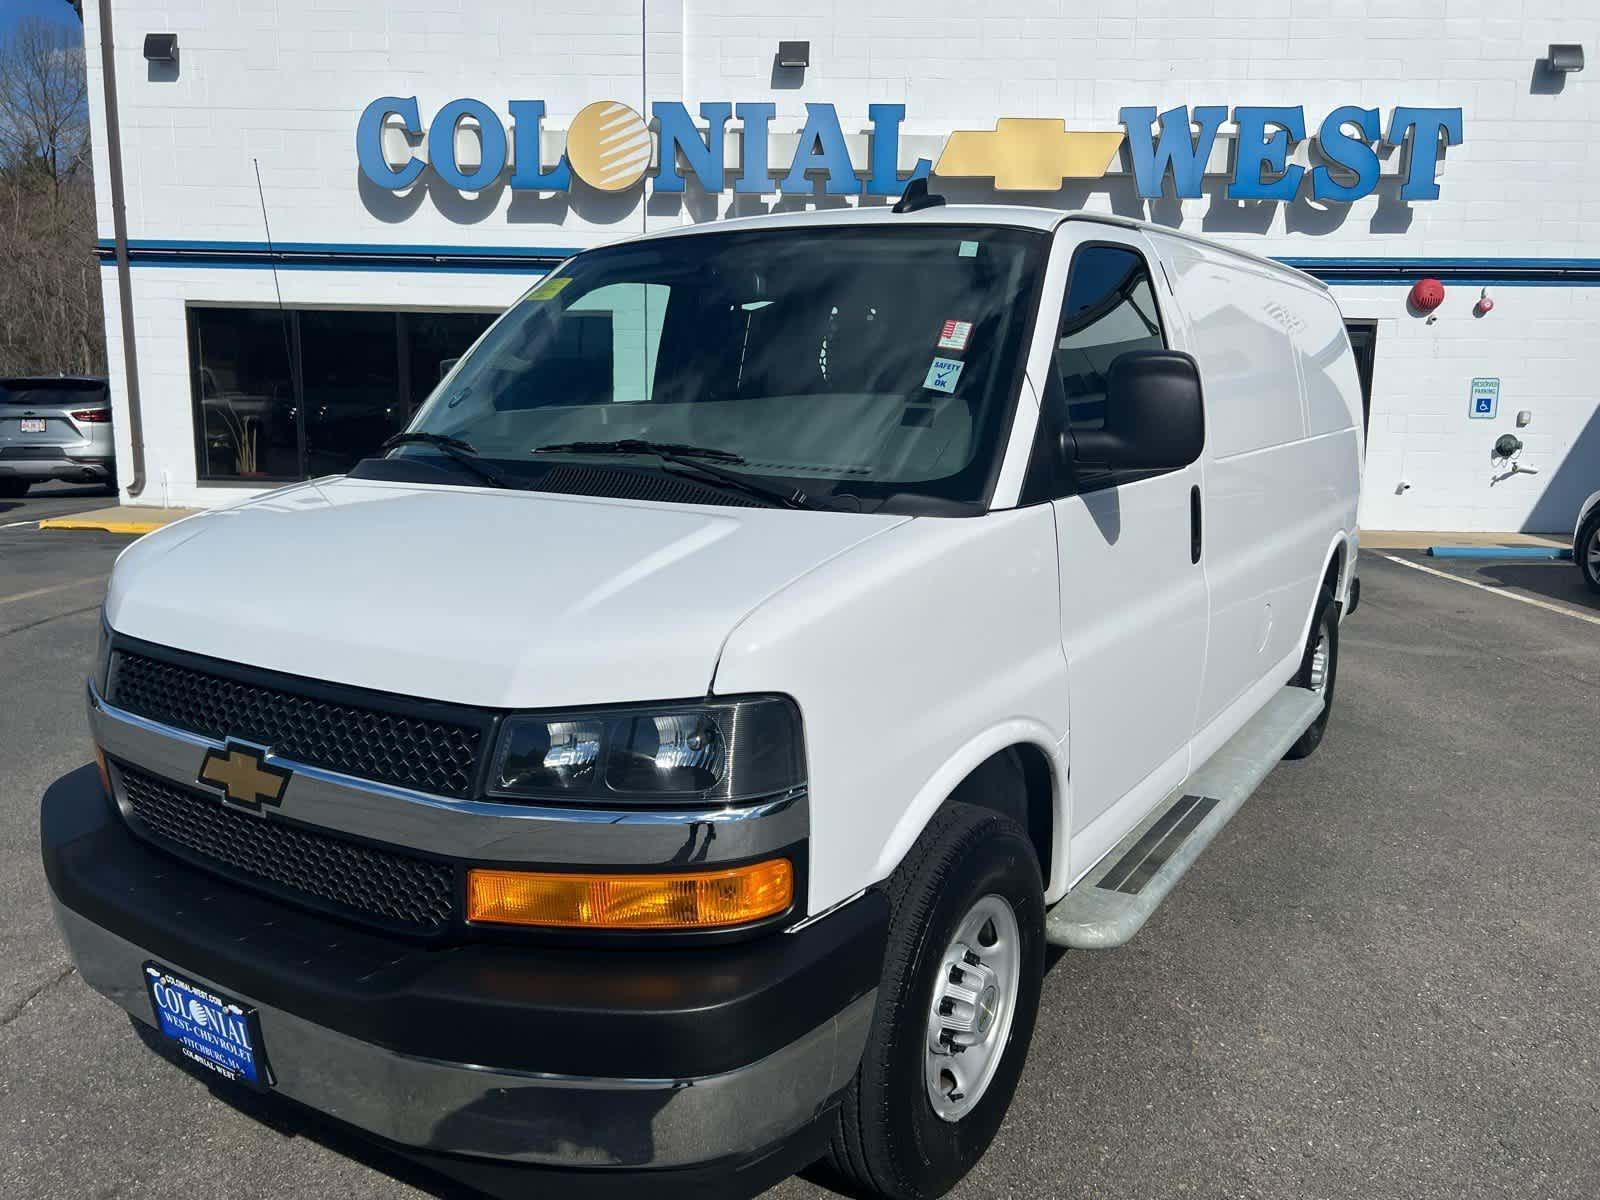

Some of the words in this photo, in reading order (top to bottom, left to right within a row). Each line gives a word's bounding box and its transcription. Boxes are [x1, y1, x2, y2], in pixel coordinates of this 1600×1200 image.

[356, 96, 932, 198] COLONIAL
[1118, 104, 1463, 202] WEST
[934, 361, 961, 371] SAFETY
[934, 379, 947, 388] OK
[154, 982, 253, 1051] COLONIAL
